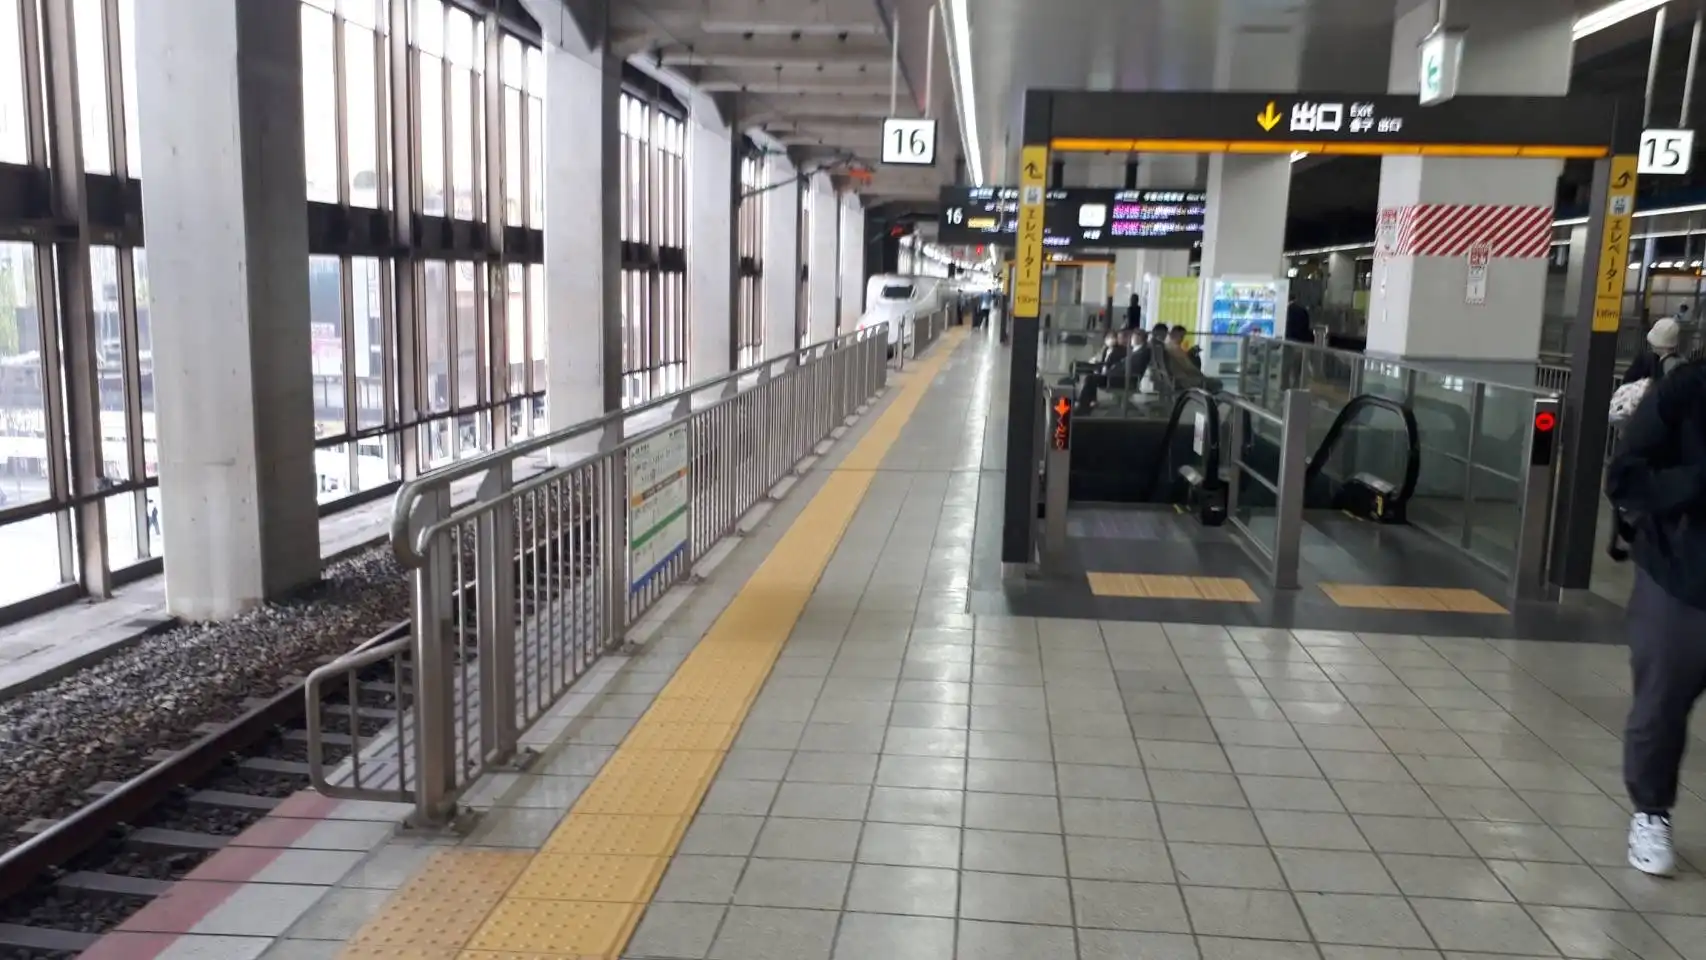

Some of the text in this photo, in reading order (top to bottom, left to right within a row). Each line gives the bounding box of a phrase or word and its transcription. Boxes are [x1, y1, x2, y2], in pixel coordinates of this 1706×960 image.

[1290, 101, 1343, 131] 出口
[1350, 102, 1374, 117] Exit
[893, 128, 926, 156] 16
[1644, 138, 1682, 168] 15
[946, 207, 963, 224] 16
[1024, 209, 1037, 278] エレベーター
[1605, 219, 1623, 292] エレベーター
